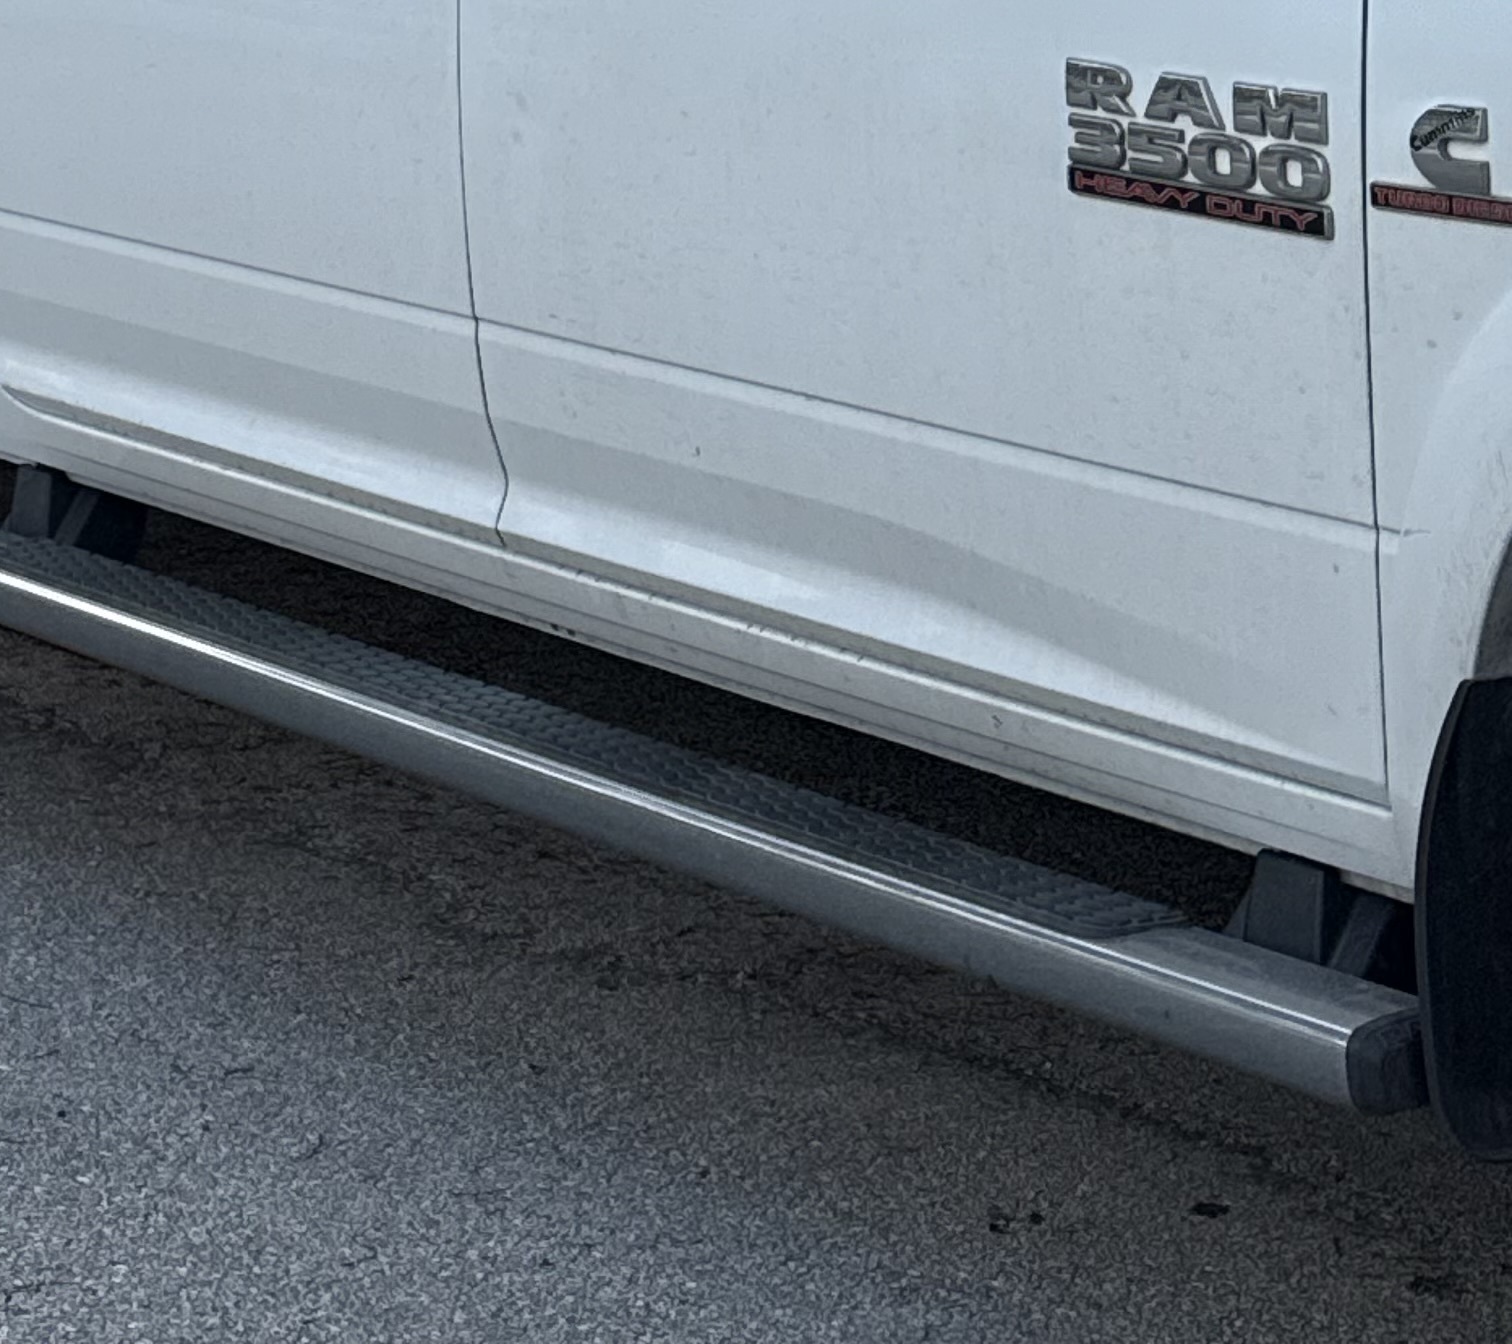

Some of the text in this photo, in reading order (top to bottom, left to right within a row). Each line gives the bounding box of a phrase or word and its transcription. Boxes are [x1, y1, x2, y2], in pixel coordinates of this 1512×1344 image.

[1065, 56, 1329, 146] RAM
[1067, 112, 1331, 203] 3500
[1074, 170, 1318, 231] HEAVY DUTY
